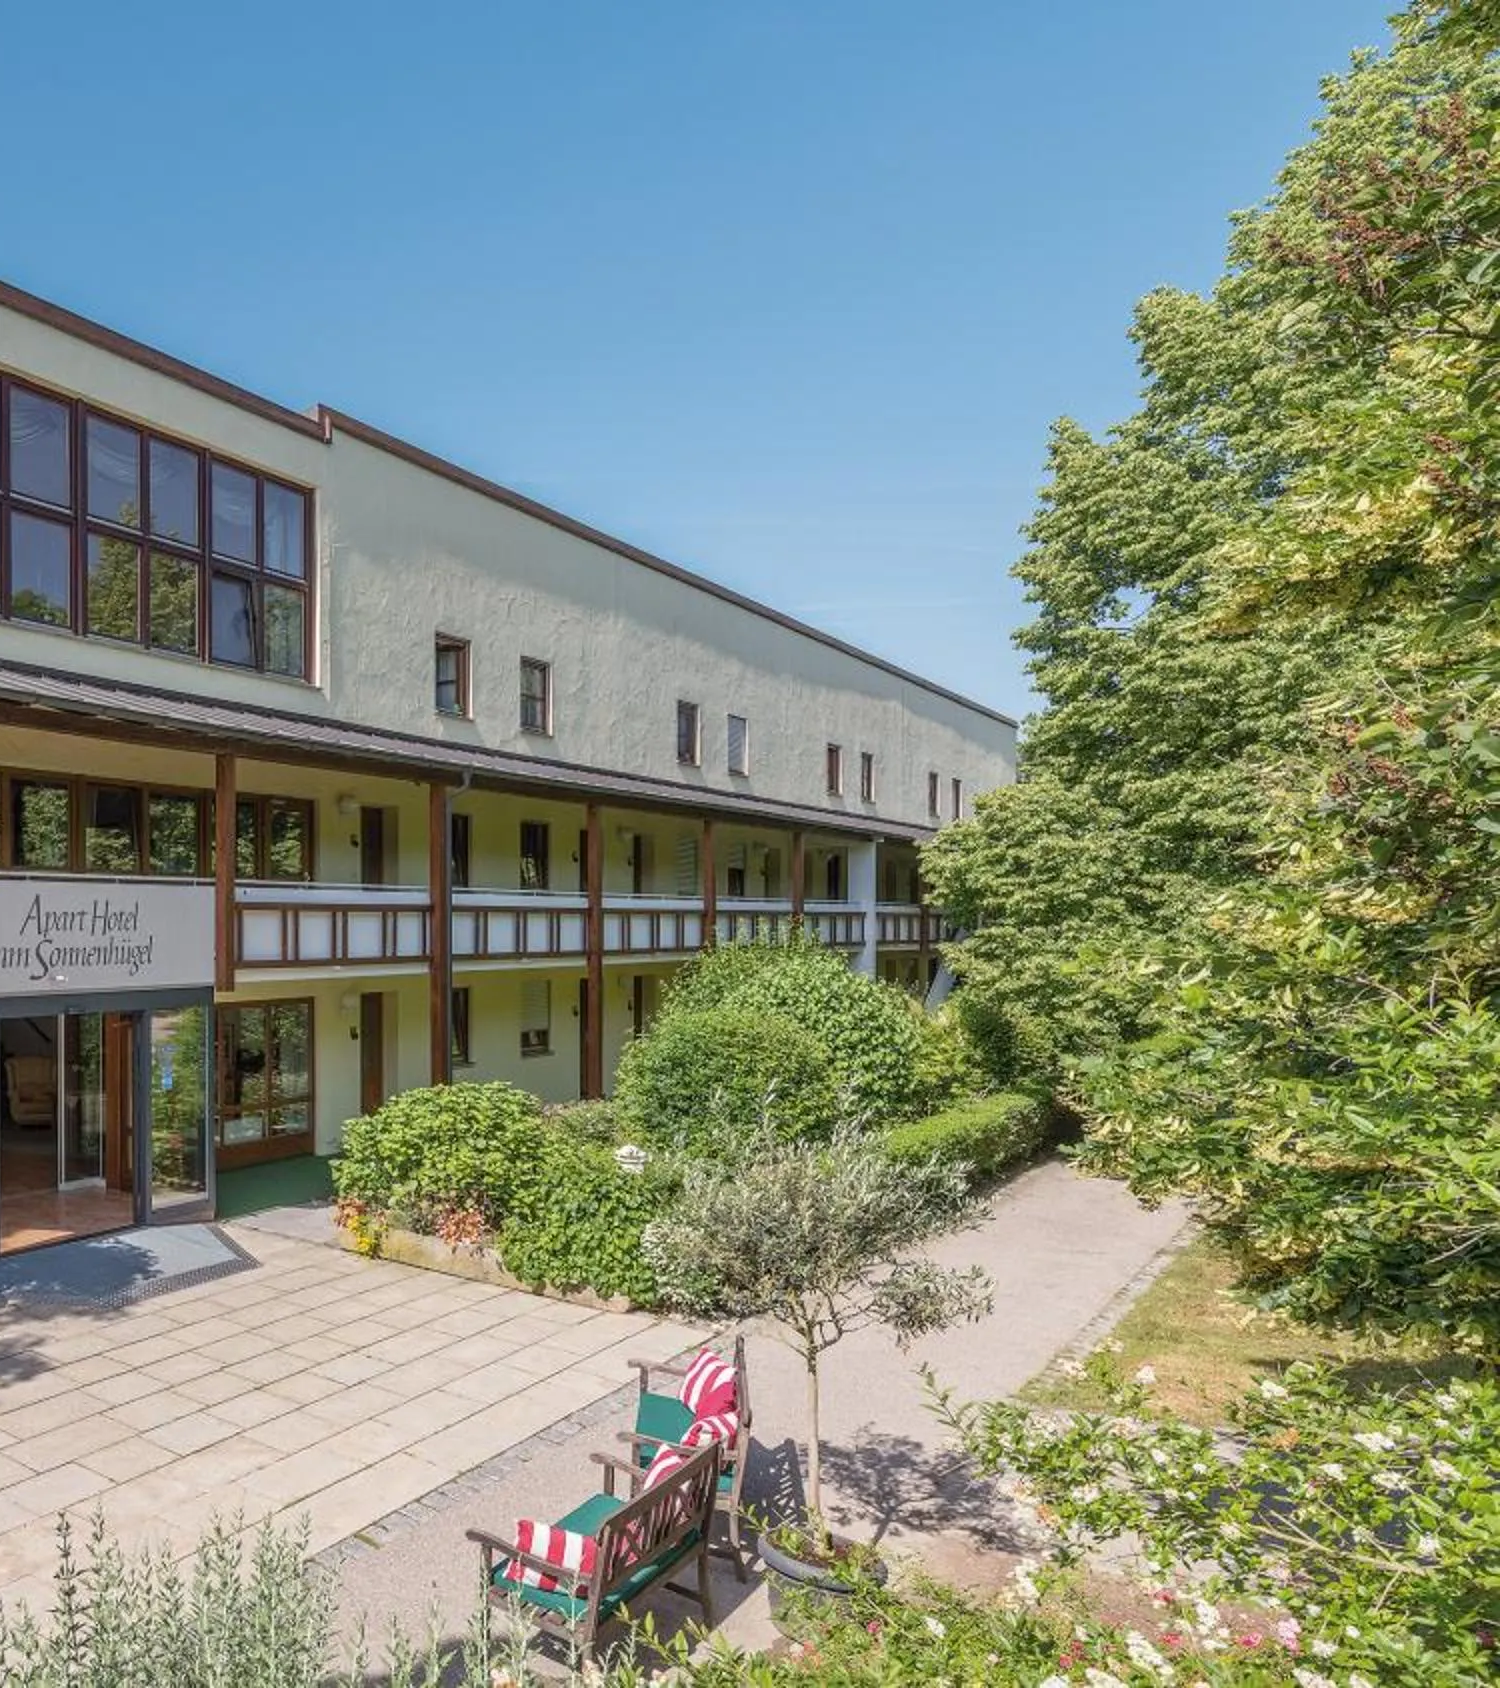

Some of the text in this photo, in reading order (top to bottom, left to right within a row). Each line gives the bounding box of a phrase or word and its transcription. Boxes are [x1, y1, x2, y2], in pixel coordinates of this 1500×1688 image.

[19, 893, 139, 938] Apart Hotel
[29, 936, 153, 980] Sonnenhügel
